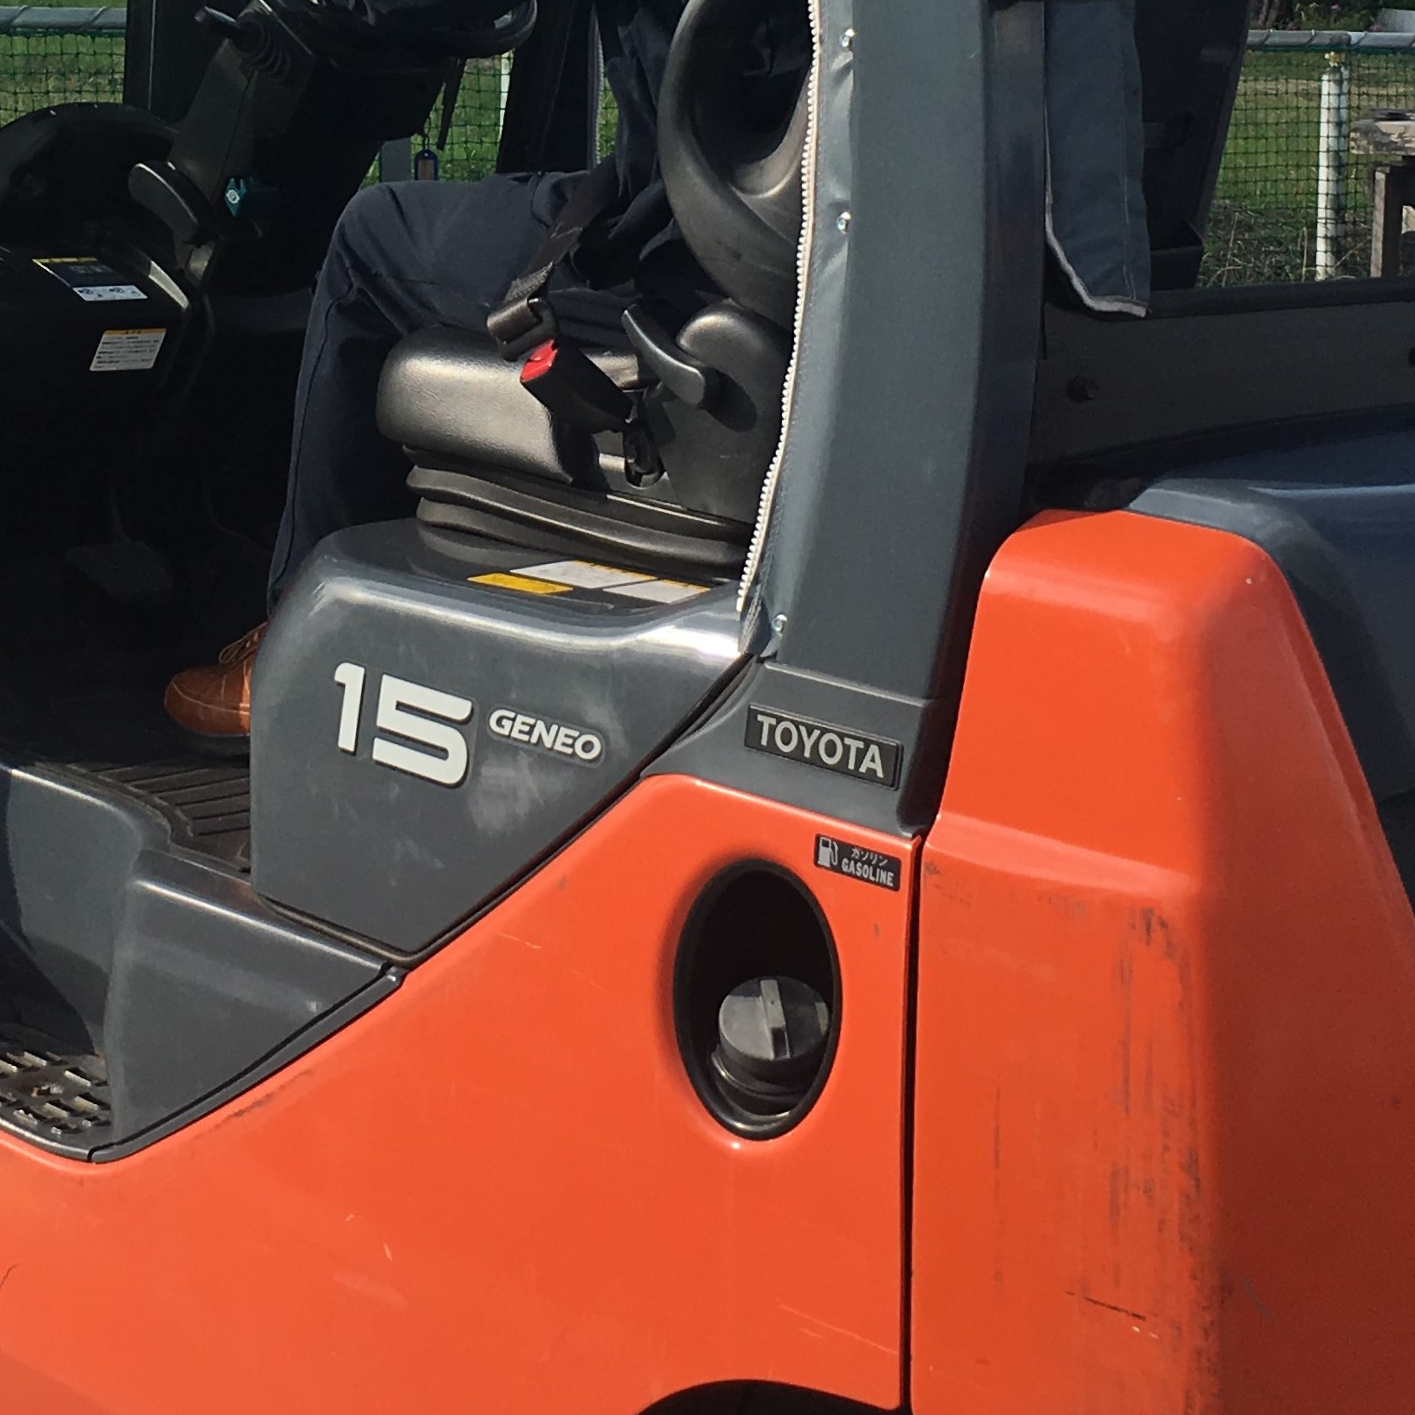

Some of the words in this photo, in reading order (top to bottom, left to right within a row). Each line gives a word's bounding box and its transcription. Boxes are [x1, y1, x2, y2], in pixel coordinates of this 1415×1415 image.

[333, 662, 472, 785] 15
[488, 708, 602, 760] GENEO
[756, 714, 885, 778] TOYOTA
[841, 858, 895, 887] GASOLINE
[850, 847, 888, 867] ガソリン
